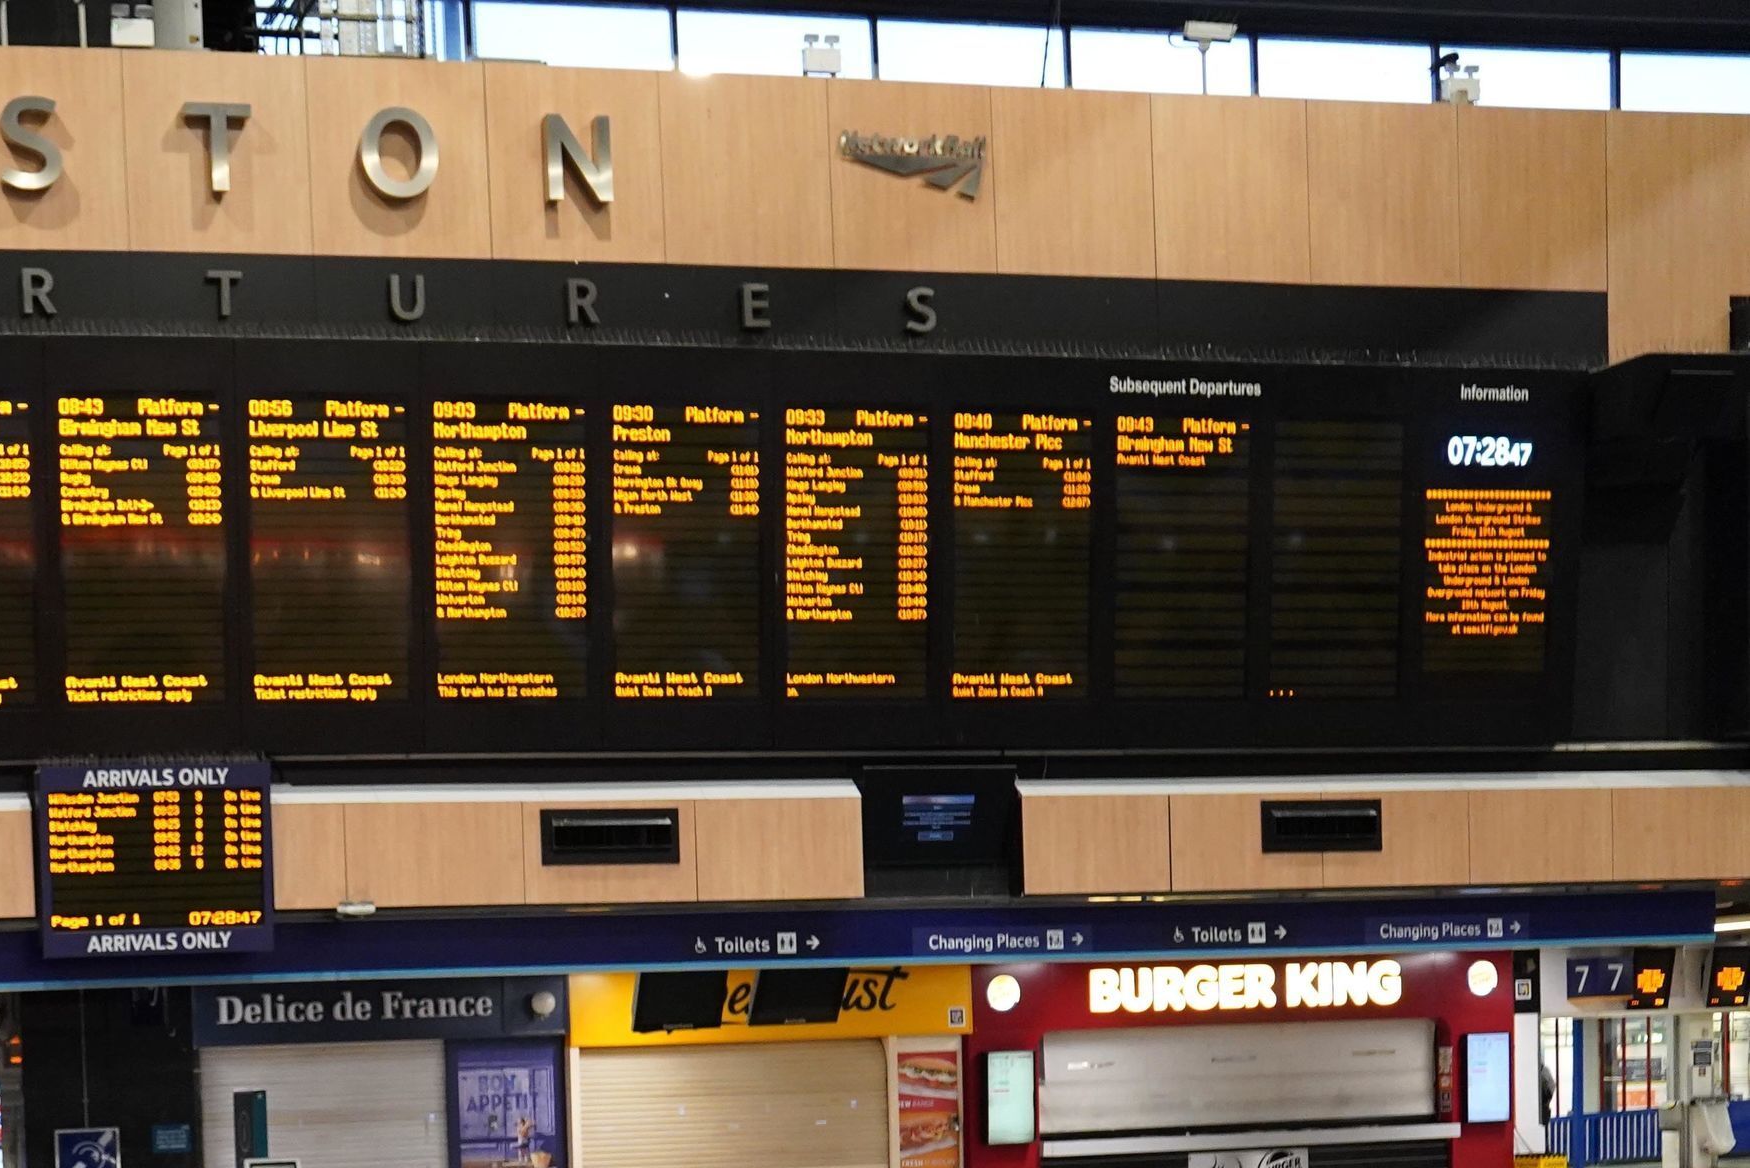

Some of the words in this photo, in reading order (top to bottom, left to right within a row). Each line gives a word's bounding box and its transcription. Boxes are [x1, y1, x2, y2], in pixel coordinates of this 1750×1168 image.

[1109, 376, 1187, 397] Subsequent
[1189, 377, 1262, 398] Departures
[1460, 384, 1529, 402] Information
[137, 397, 204, 416] Platform
[325, 400, 390, 418] Platform
[508, 402, 570, 420] Platform
[613, 404, 654, 422] 09:30
[685, 406, 745, 424] Platform
[58, 418, 142, 438] Birmingham
[146, 418, 177, 436] New
[181, 418, 200, 436] St
[786, 409, 825, 427] 09:33
[856, 409, 914, 427] Platform
[954, 412, 993, 430] 09:40
[1022, 414, 1078, 432] Platform
[1117, 416, 1154, 432] 09:43
[1182, 417, 1236, 434] Platform
[249, 420, 318, 439] Liverpool
[323, 420, 356, 438] Lime
[360, 421, 379, 438] St
[433, 421, 527, 442] Northampton
[612, 424, 671, 443] Preston
[786, 428, 873, 448] Northampton
[954, 432, 1031, 450] Manchester
[1035, 433, 1063, 451] Picc
[1117, 435, 1184, 454] Birmingham
[1189, 436, 1213, 453] New
[1218, 437, 1233, 453] St
[82, 768, 174, 788] ARRIVALS
[178, 767, 229, 786] ONLY
[51, 915, 89, 929] Page
[95, 914, 103, 926] 1
[108, 913, 126, 926] of
[132, 913, 140, 926] 1
[188, 910, 262, 926] 07:28:47
[1191, 924, 1242, 943] Toilets
[1379, 922, 1441, 942] Changing
[1444, 920, 1481, 938] Places
[87, 933, 178, 953] ARRIVALS
[182, 931, 232, 949] ONLY
[714, 936, 771, 955] Toilets
[928, 933, 993, 953] Changing
[996, 932, 1040, 950] Places
[1088, 963, 1276, 1014] BURGER
[1285, 958, 1403, 1009] KING
[1575, 965, 1591, 994] 7
[1607, 963, 1624, 992] 7
[216, 994, 324, 1026] Delice
[333, 991, 371, 1022] de
[380, 992, 493, 1020] France
